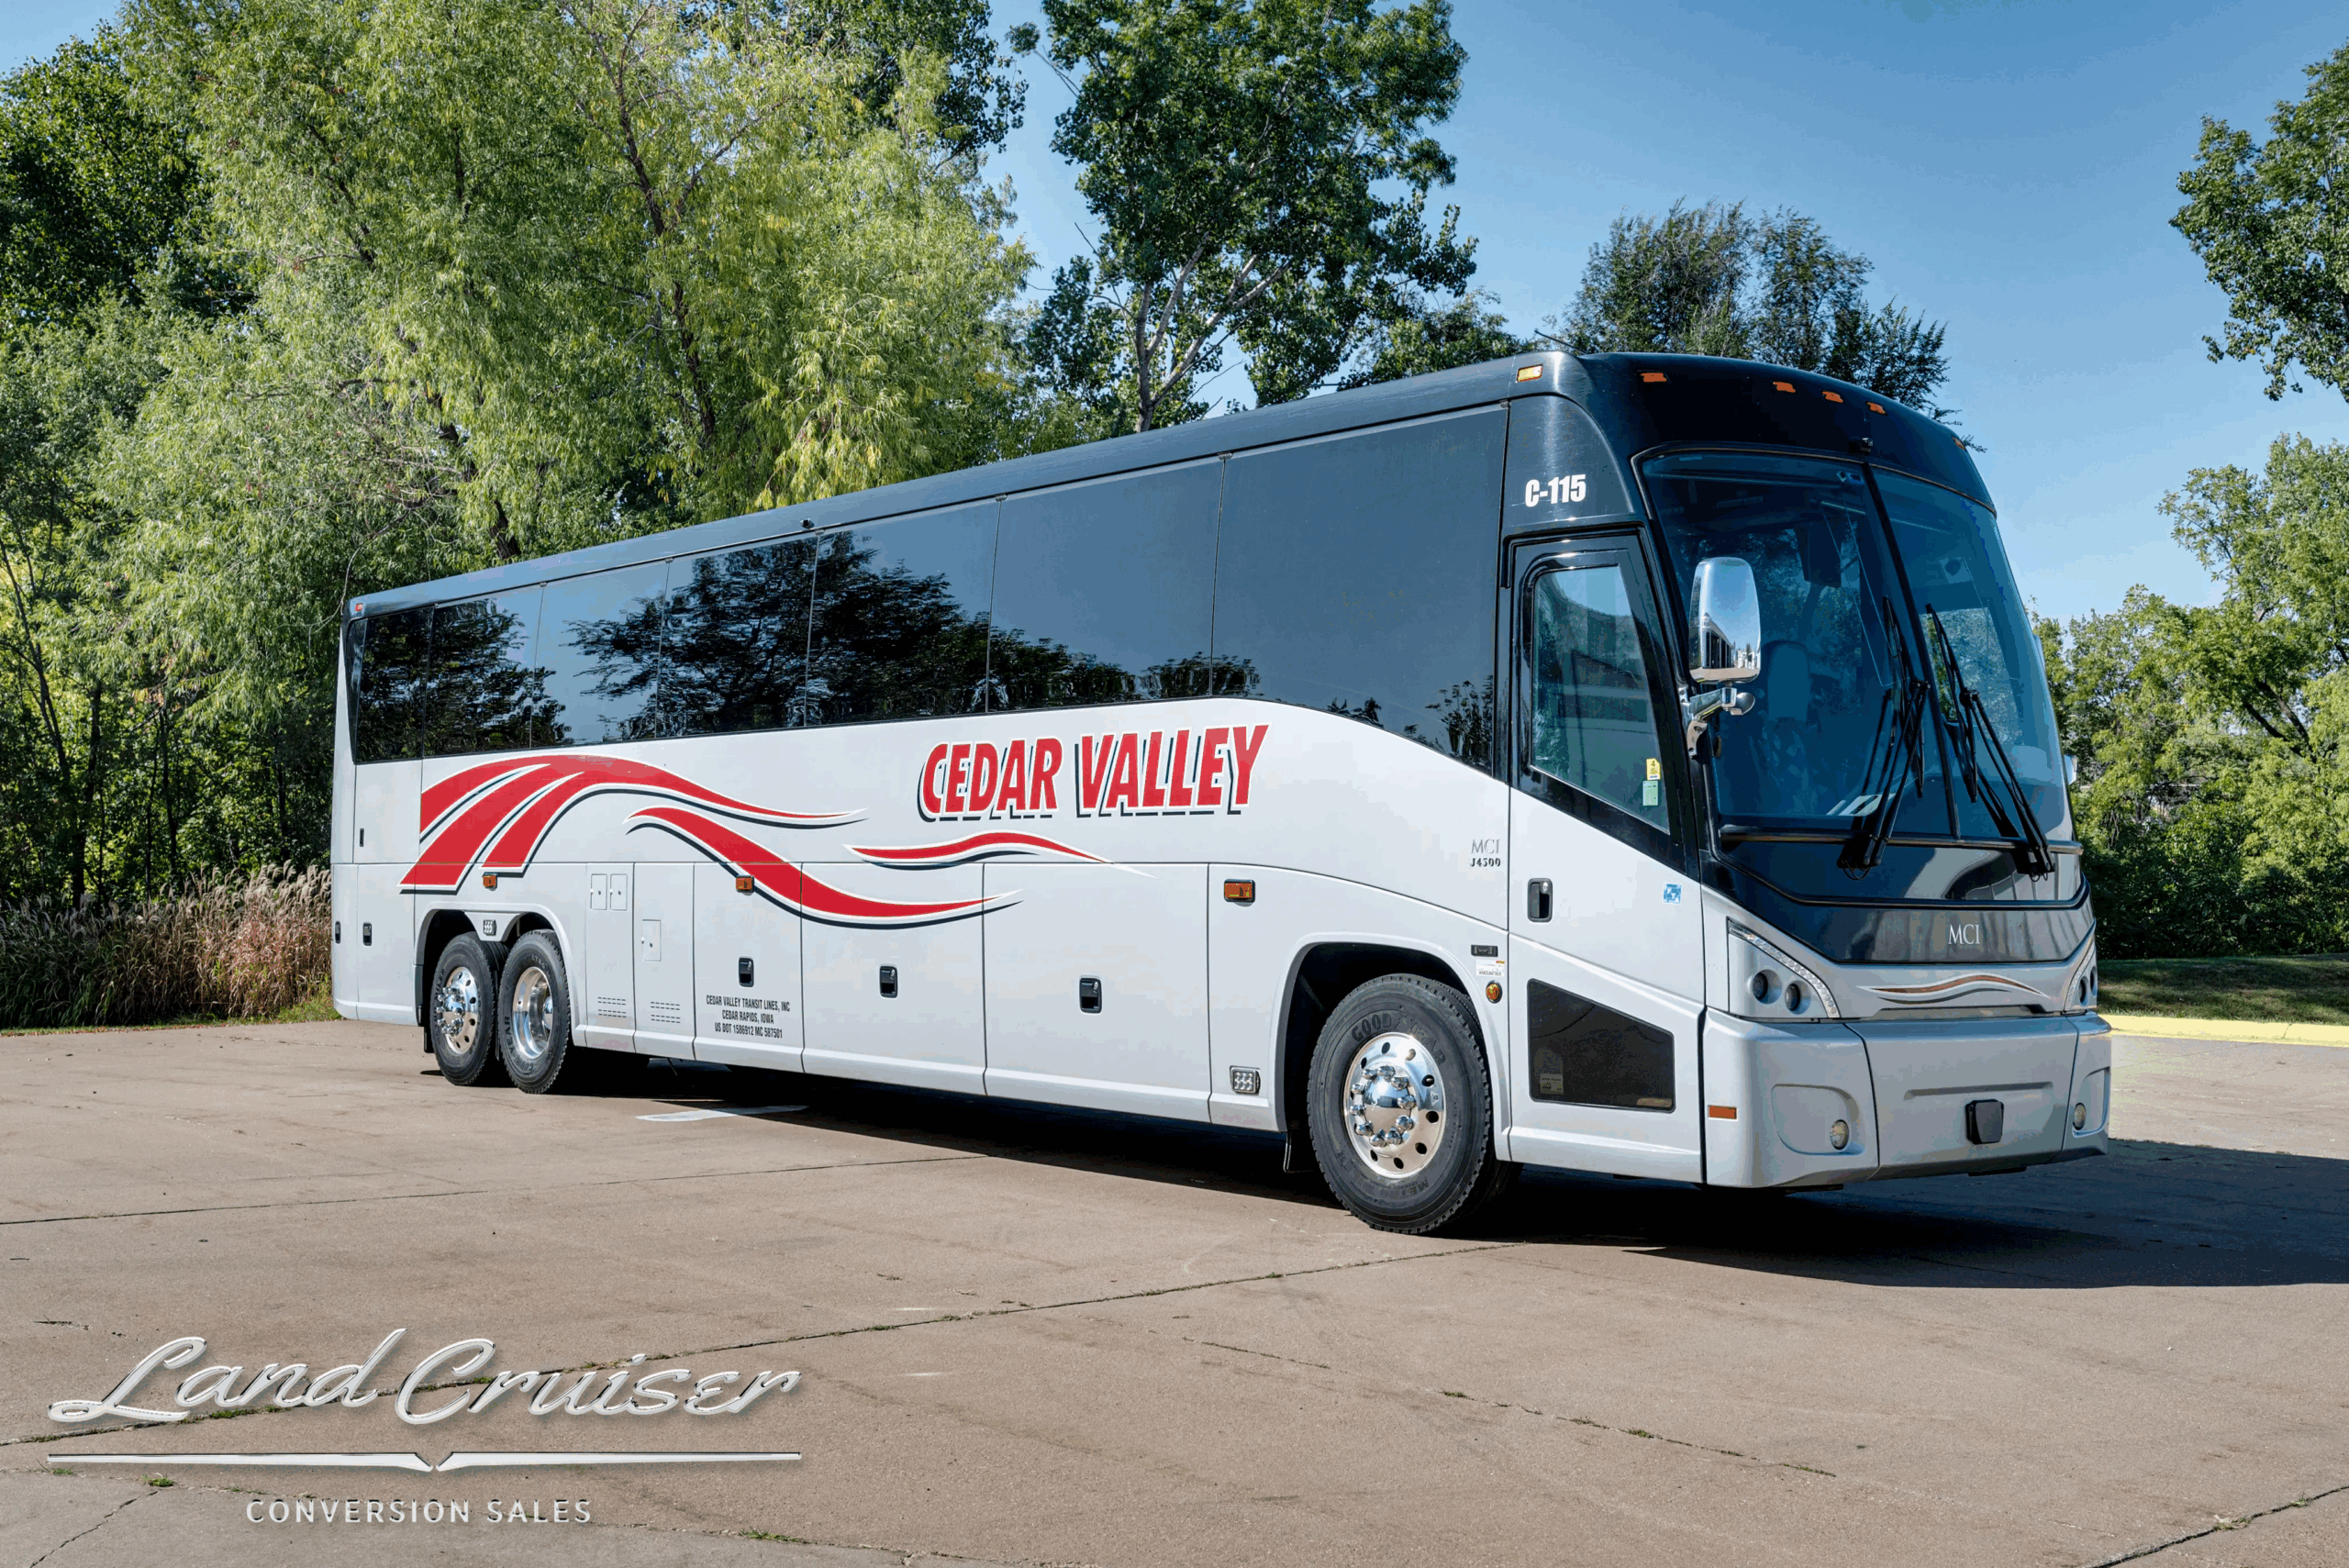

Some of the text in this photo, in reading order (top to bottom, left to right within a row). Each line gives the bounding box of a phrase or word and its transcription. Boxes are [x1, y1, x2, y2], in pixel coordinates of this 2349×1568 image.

[1525, 473, 1586, 507] C-115
[918, 723, 1270, 822] CEDAR VALLEY
[1471, 839, 1500, 854] MCI
[1470, 857, 1502, 868] J4500
[1947, 923, 1981, 945] MCI
[706, 995, 790, 1012] CEDAR VALLEY TRANSIT LINES, INC
[722, 1009, 774, 1024] CEDAR RAPIDS, IOWA
[714, 1022, 721, 1032] US
[722, 1023, 732, 1033] DOT
[754, 1026, 763, 1037] MC
[1352, 1011, 1447, 1066] GOODYEAR
